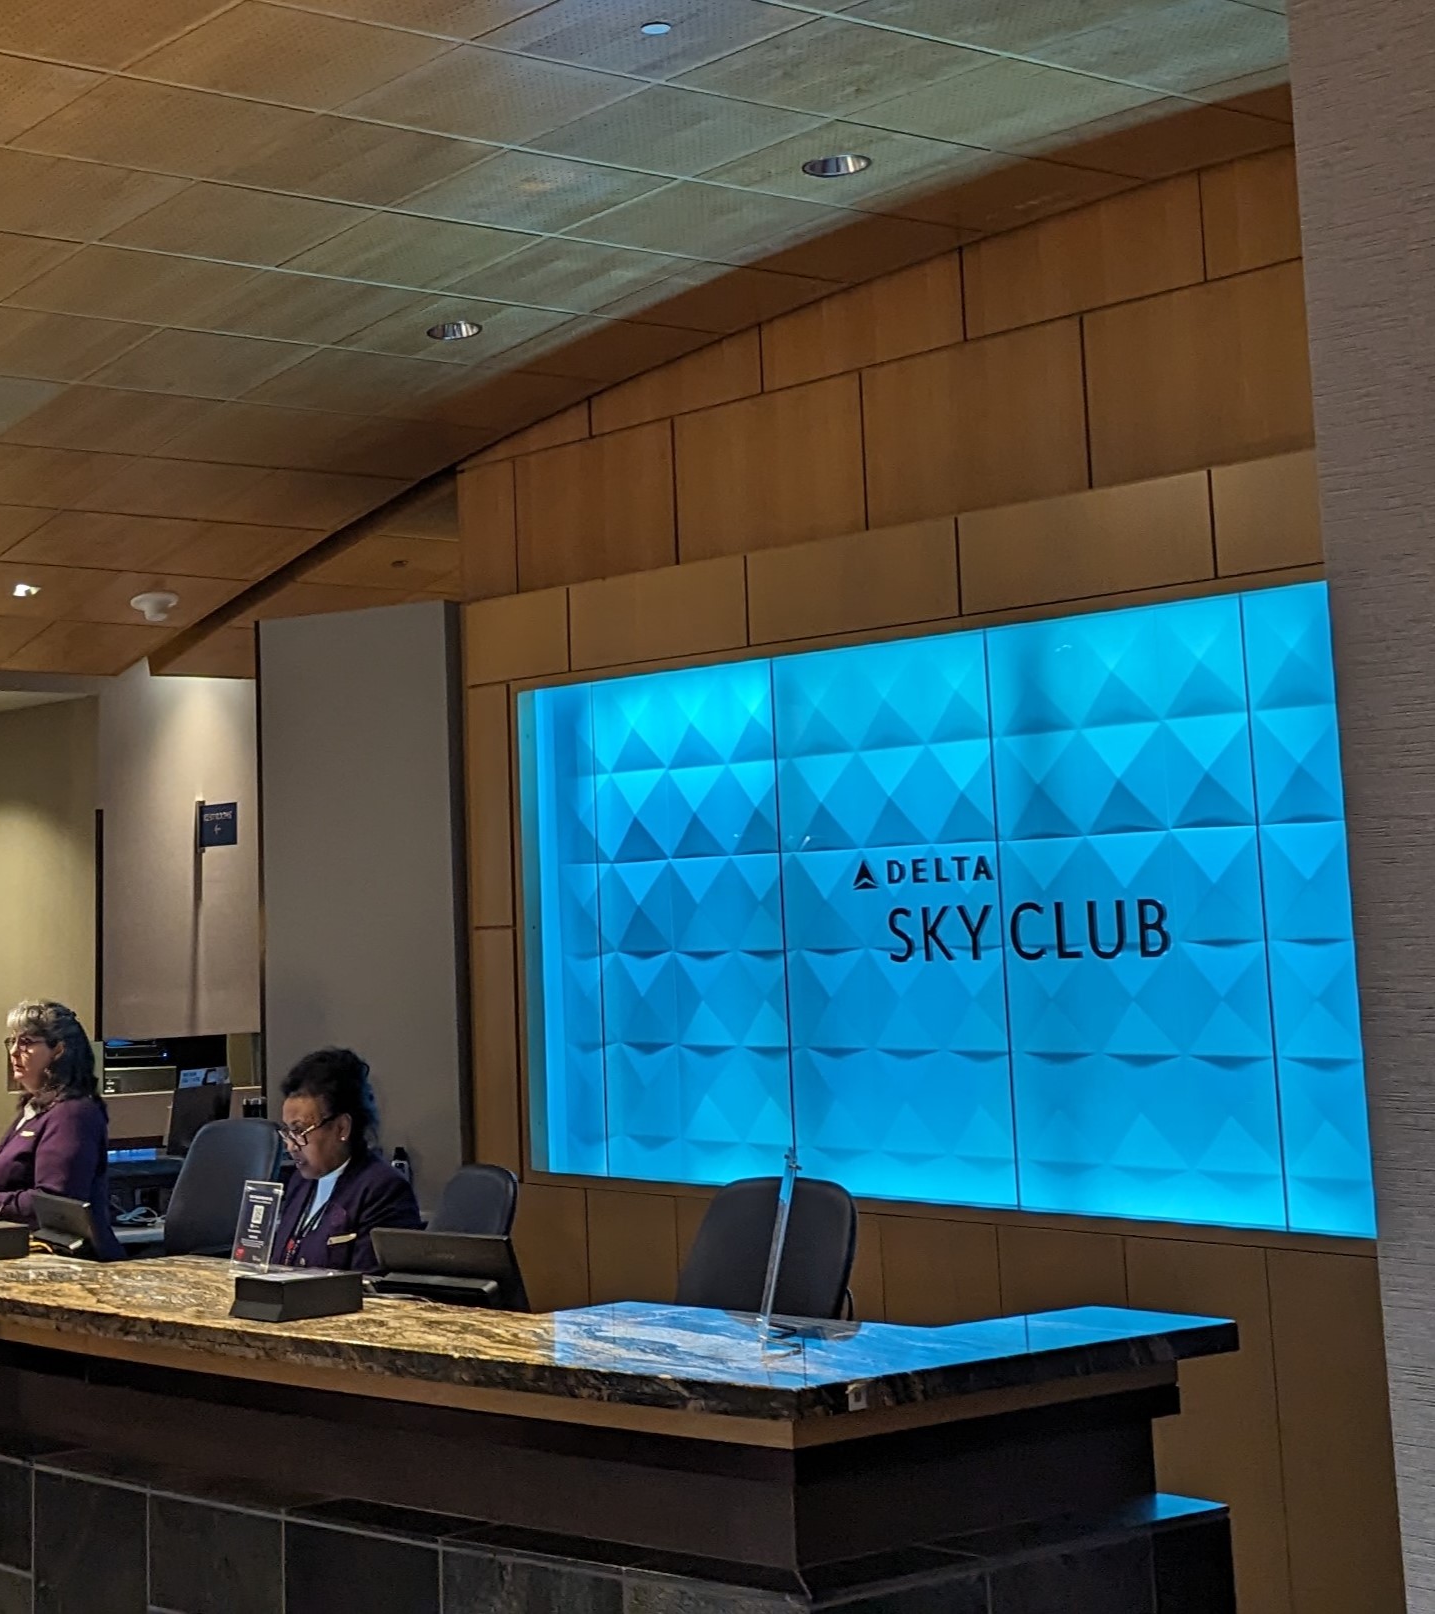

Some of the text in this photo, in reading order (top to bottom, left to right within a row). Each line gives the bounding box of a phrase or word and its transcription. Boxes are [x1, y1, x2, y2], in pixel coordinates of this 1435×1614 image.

[886, 855, 995, 884] DELTA
[887, 898, 1172, 963] SKY CLUB
